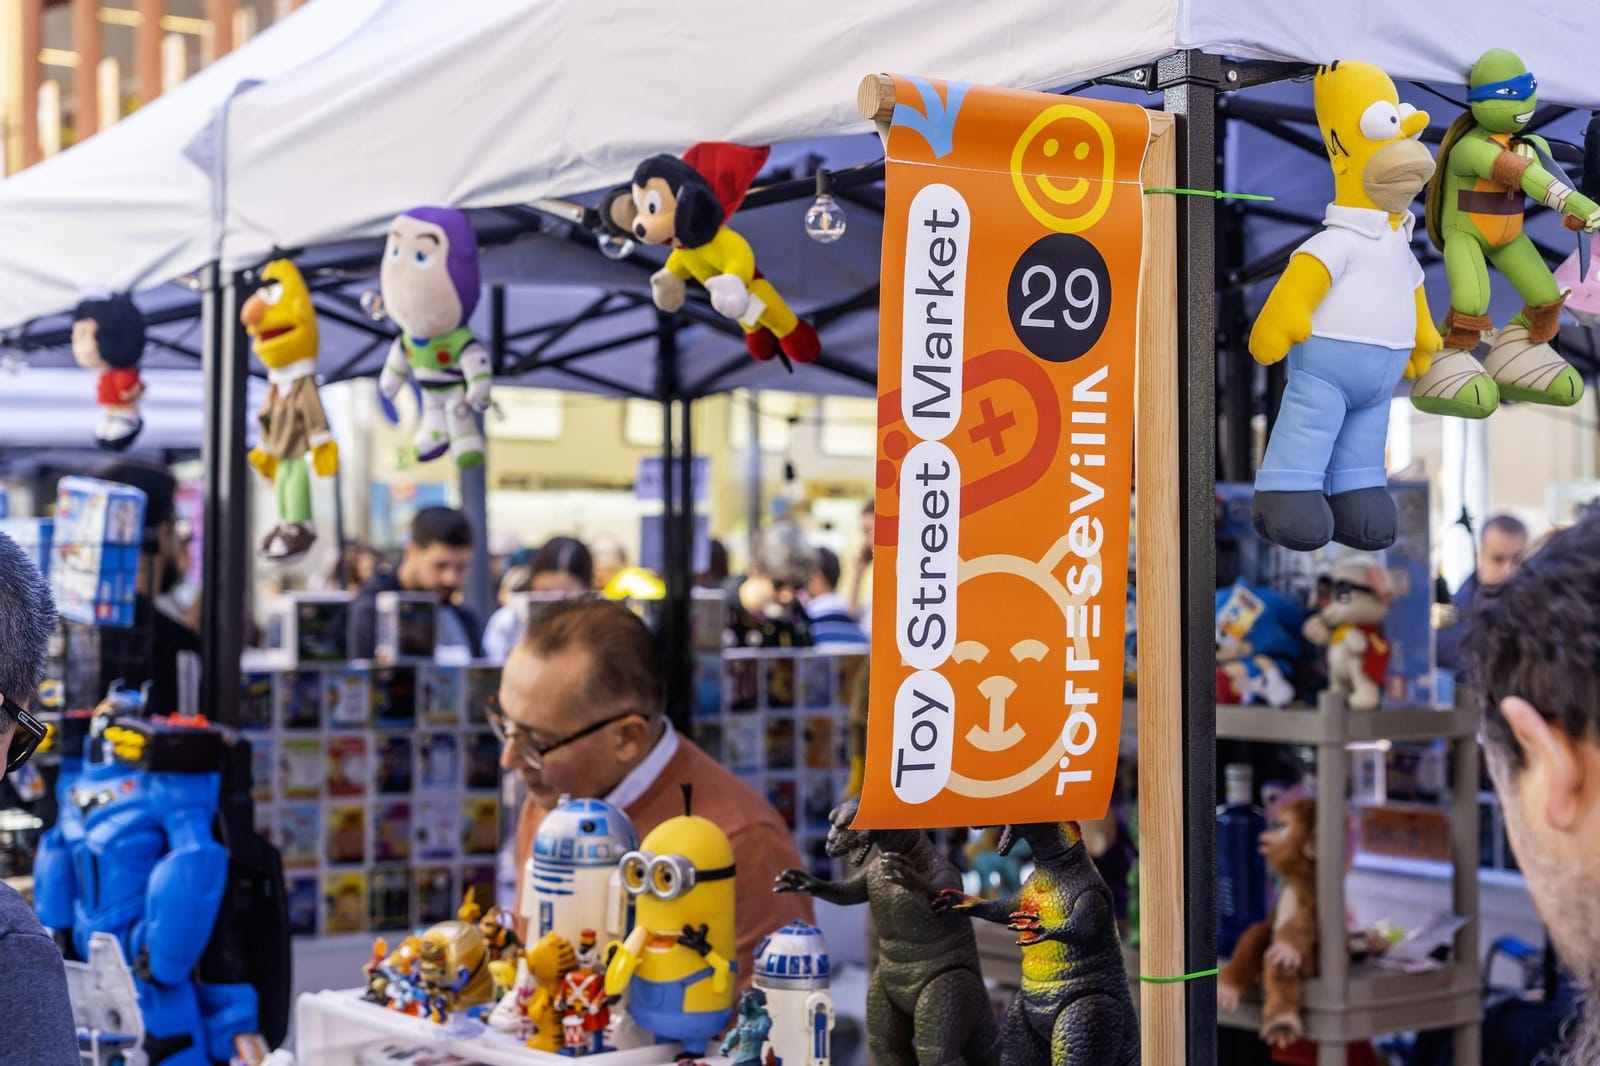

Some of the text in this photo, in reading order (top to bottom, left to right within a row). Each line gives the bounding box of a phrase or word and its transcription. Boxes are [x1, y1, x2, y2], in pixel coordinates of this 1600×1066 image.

[1020, 264, 1100, 331] 29
[895, 207, 960, 788] Toy Street Market
